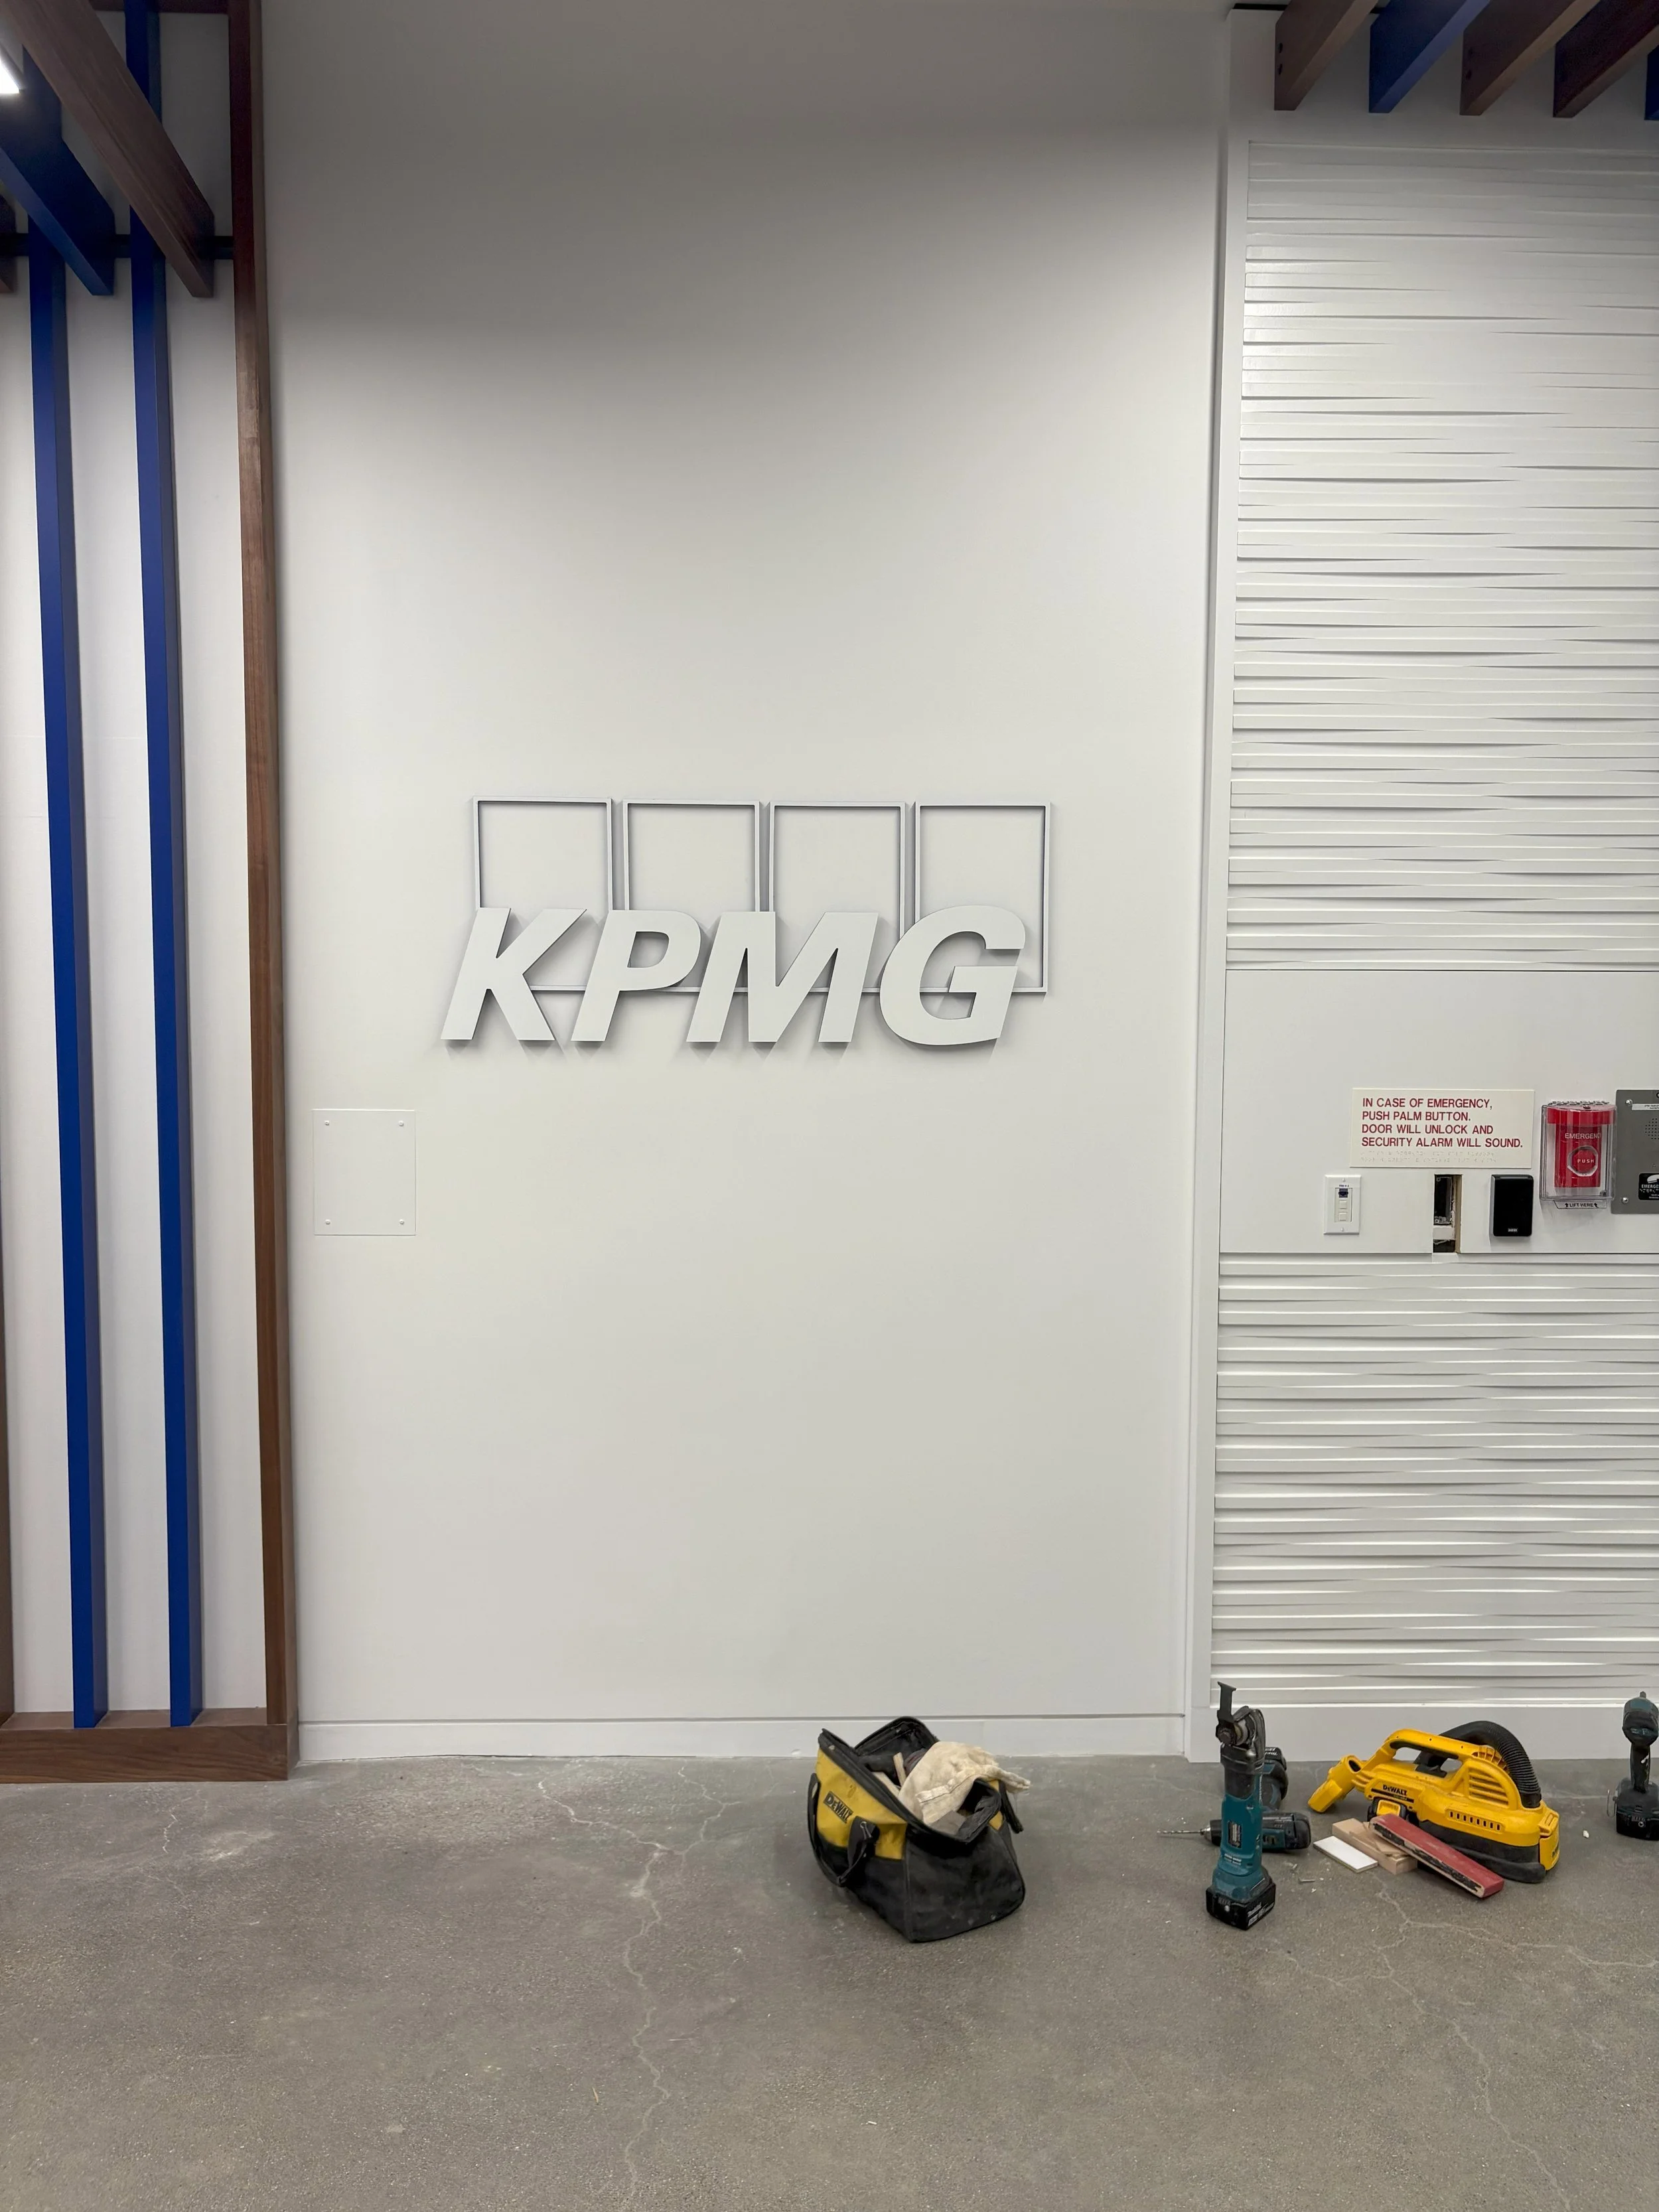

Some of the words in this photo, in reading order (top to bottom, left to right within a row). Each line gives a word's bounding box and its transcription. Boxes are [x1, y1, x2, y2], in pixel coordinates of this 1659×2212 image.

[440, 905, 1026, 1047] KPMG
[1362, 1098, 1373, 1107] IN
[1376, 1098, 1405, 1108] CASE
[1409, 1098, 1424, 1108] OF
[1427, 1098, 1493, 1110] EMERGENCY,
[1362, 1111, 1390, 1121] PUSH
[1393, 1111, 1421, 1121] PALM
[1425, 1112, 1471, 1122] BUTTON.
[1361, 1124, 1393, 1134] DOOR
[1396, 1124, 1421, 1134] WILL
[1425, 1125, 1469, 1135] UNLOCK
[1472, 1125, 1493, 1135] AND
[1361, 1137, 1412, 1147] SECURITY
[1415, 1138, 1453, 1147] ALARM
[1457, 1138, 1481, 1147] WILL
[1484, 1138, 1523, 1148] SOUND.
